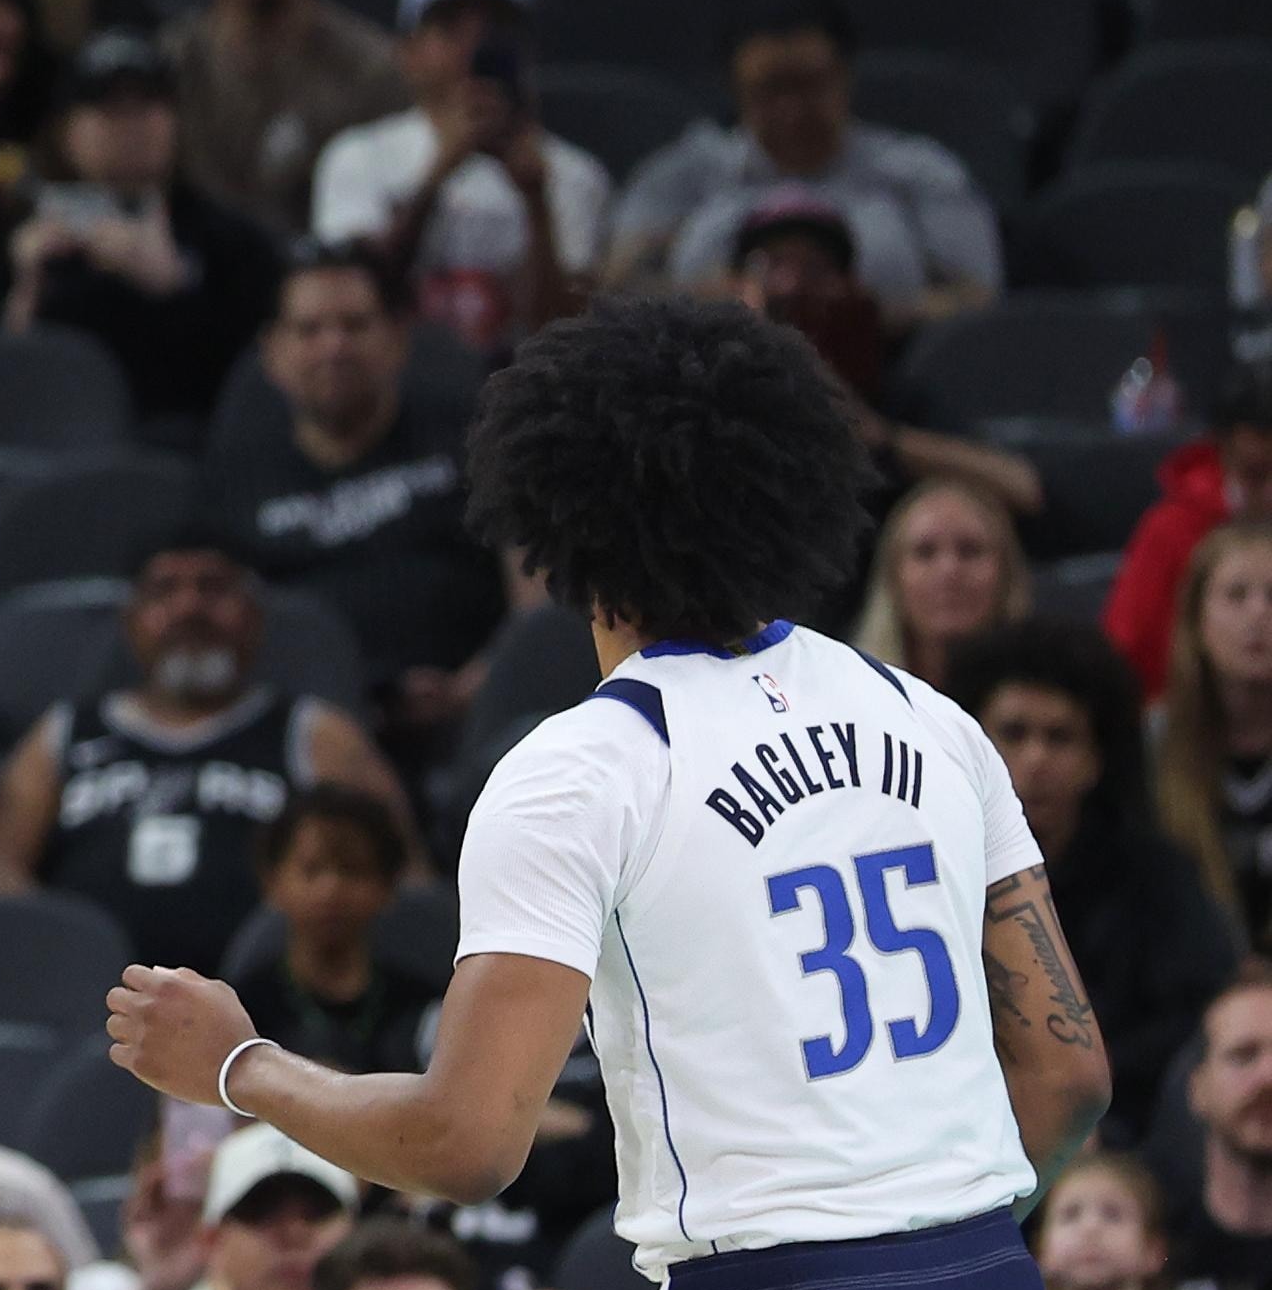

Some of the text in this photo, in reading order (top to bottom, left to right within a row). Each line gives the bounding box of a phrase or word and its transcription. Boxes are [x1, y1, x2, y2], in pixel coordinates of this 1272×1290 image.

[705, 722, 923, 848] BAGLEY III
[764, 840, 962, 1083] 35
